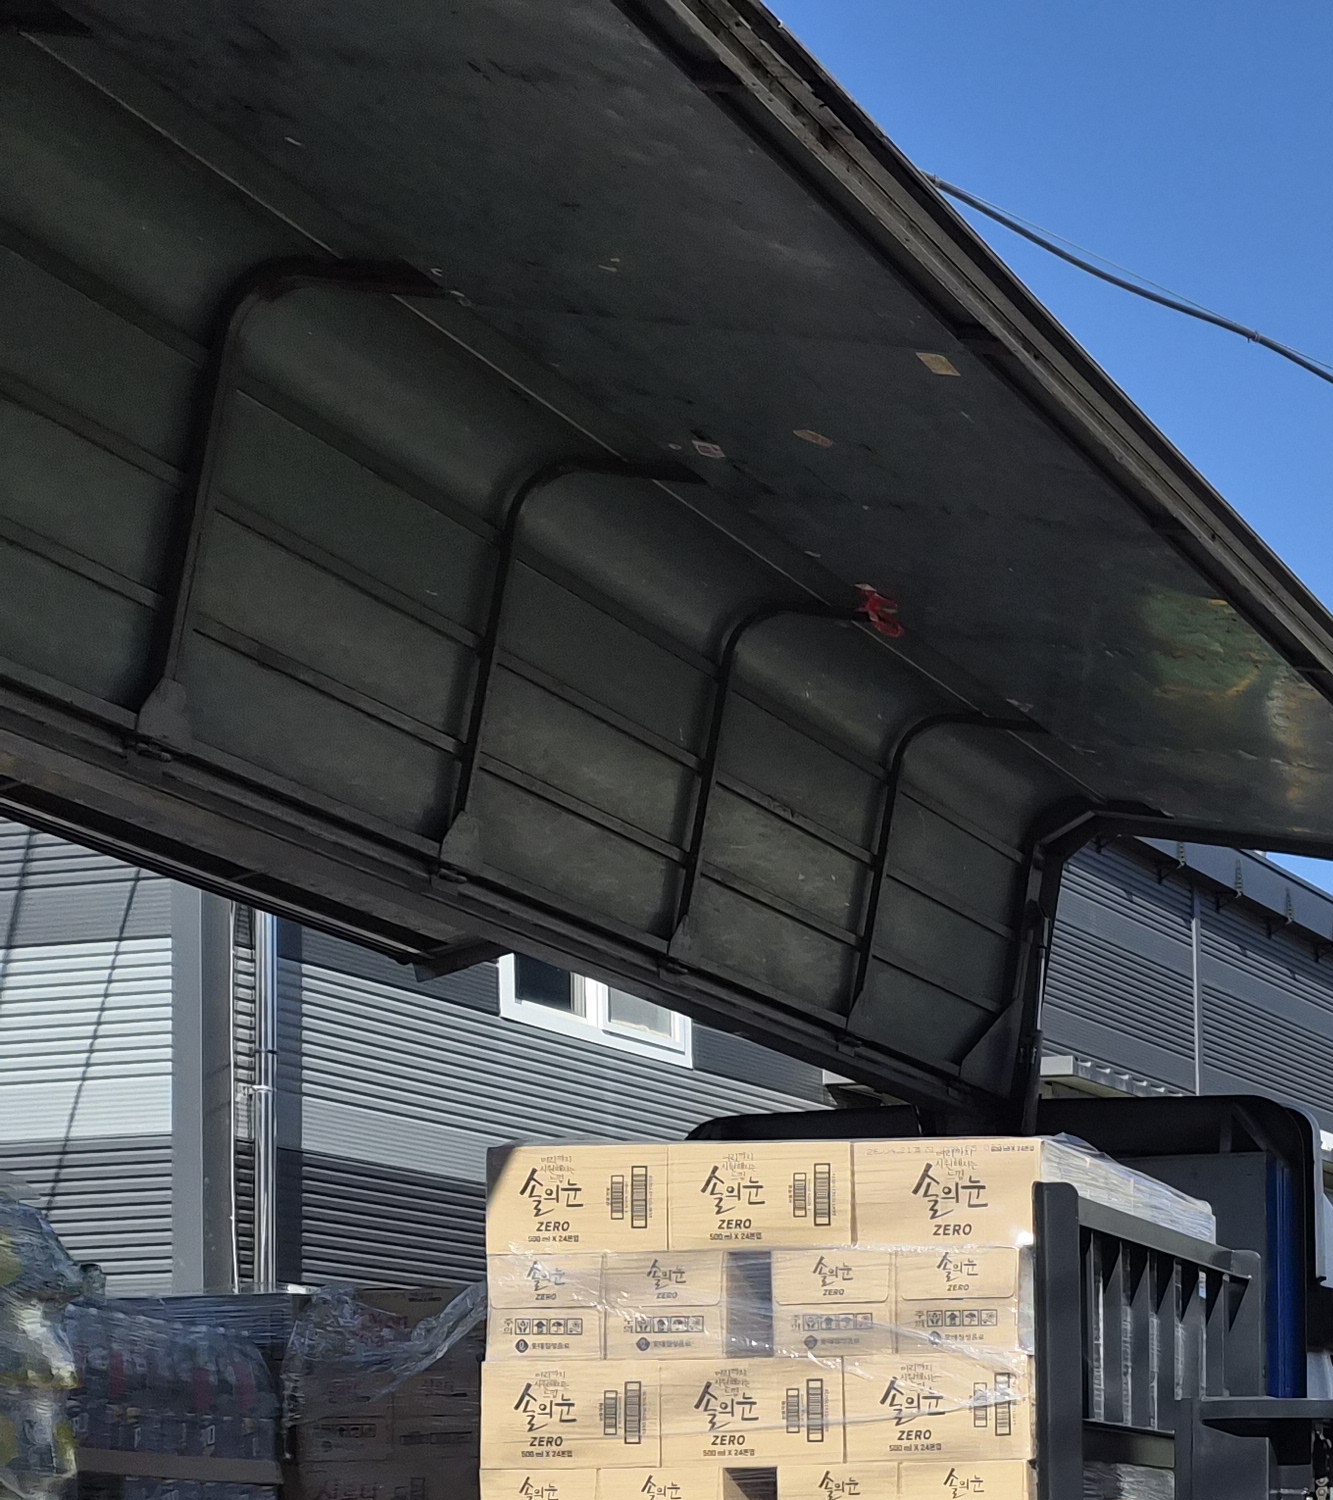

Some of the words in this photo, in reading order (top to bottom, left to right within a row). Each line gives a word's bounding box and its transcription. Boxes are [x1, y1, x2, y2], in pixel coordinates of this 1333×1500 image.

[520, 1168, 584, 1217] 솔의눈
[701, 1165, 765, 1215] 솔의눈
[912, 1162, 988, 1220] 솔의눈
[536, 1221, 570, 1231] ZERO
[718, 1219, 751, 1230] ZERO
[933, 1224, 972, 1235] ZERO
[647, 1259, 686, 1290] 솔의눈
[813, 1256, 853, 1287] 솔의눈
[937, 1252, 979, 1283] 솔의눈
[514, 1383, 577, 1432] 솔의눈
[694, 1381, 759, 1431] 솔의눈
[529, 1436, 563, 1447] ZERO
[711, 1435, 745, 1445] ZERO
[897, 1429, 931, 1440] ZERO
[819, 1470, 860, 1500] 솔의눈
[943, 1467, 985, 1499] 솔의눈
